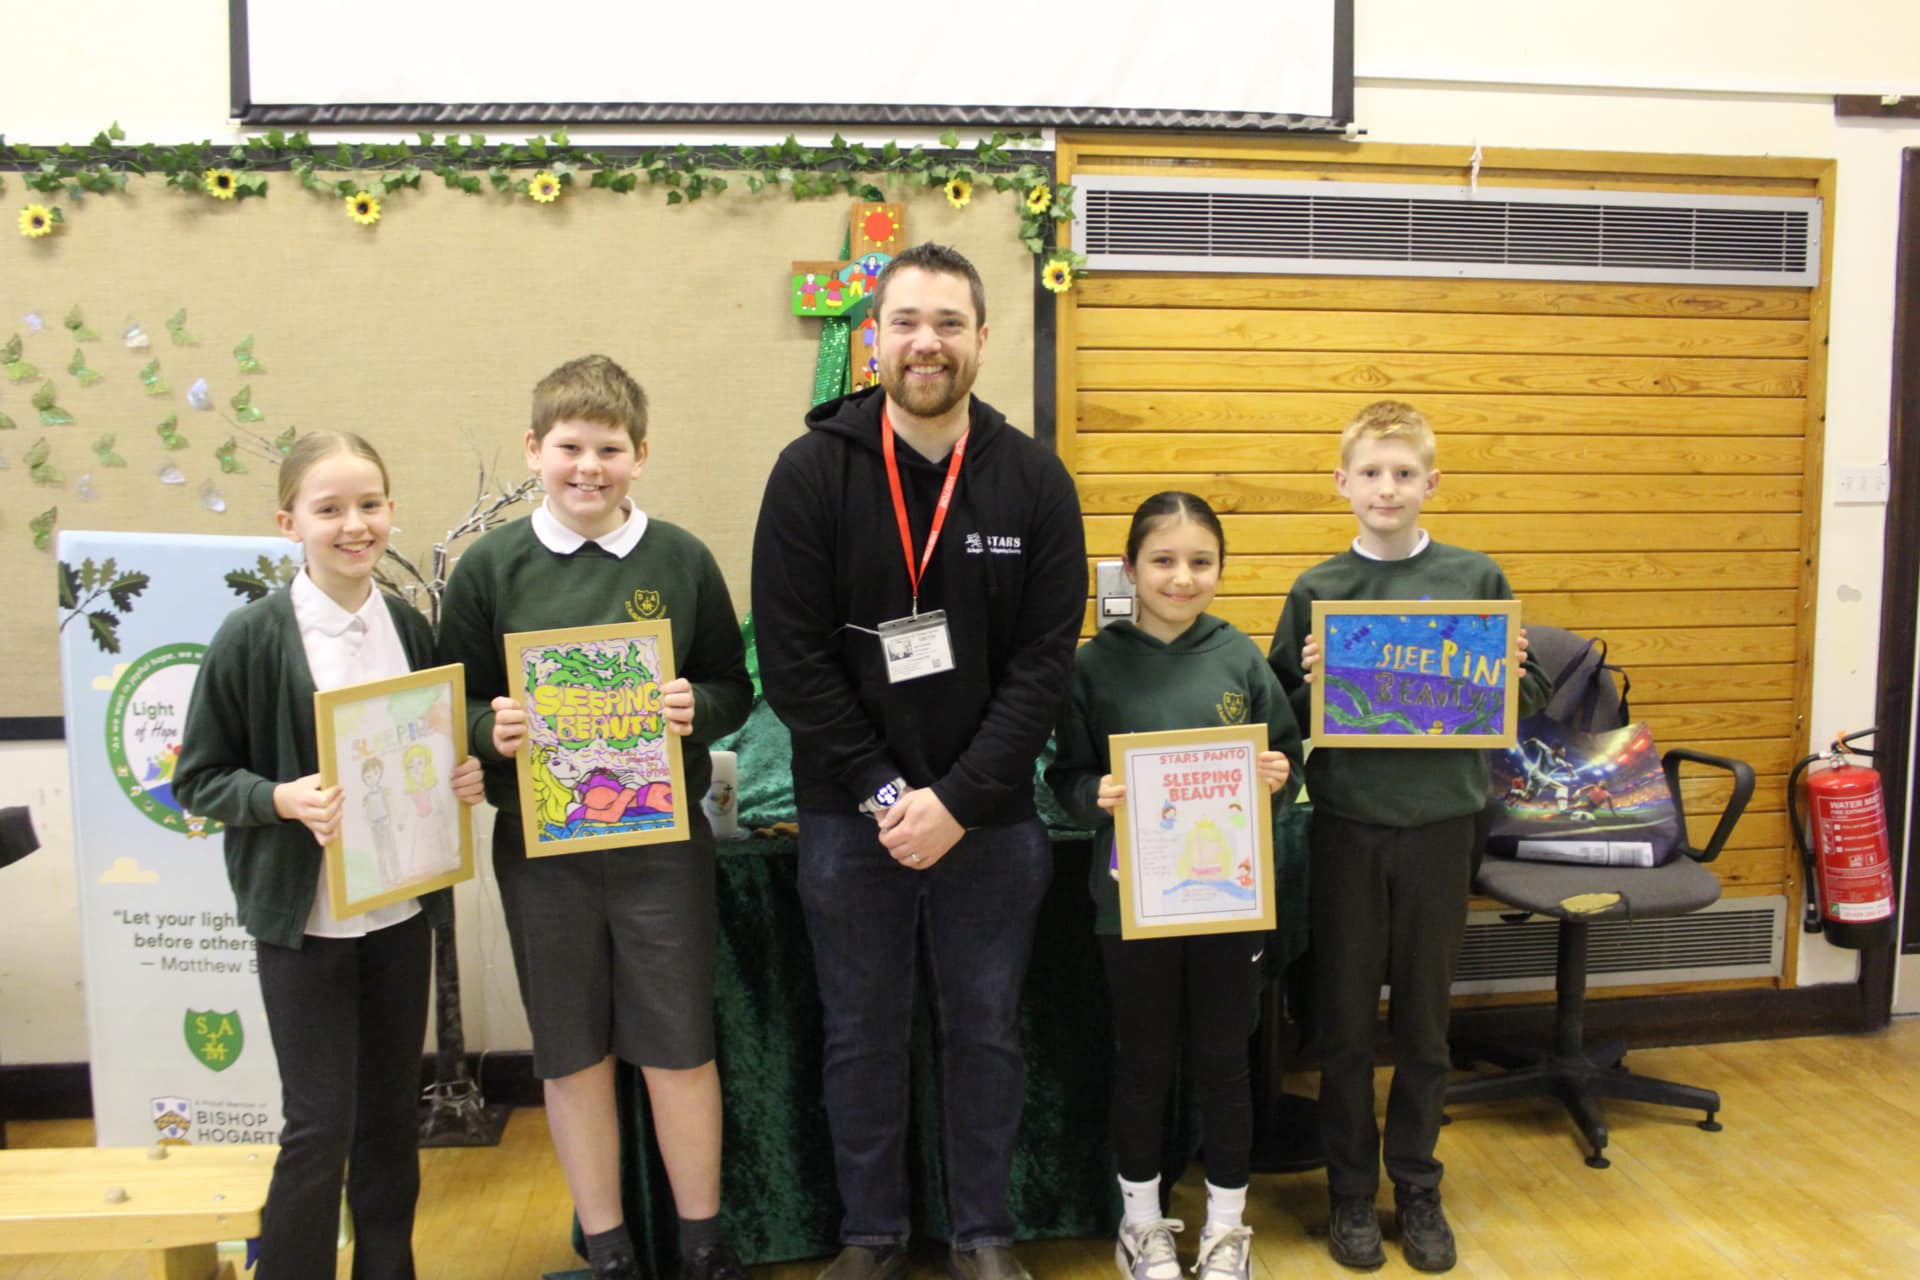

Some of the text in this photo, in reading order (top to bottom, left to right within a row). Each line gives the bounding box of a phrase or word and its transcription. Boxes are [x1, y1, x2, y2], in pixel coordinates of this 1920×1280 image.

[534, 681, 661, 716] SLEEPING
[132, 702, 175, 720] Light
[135, 720, 178, 744] of Hope
[556, 714, 660, 740] BEAUTY
[1160, 748, 1246, 765] STARS PANTO
[1162, 768, 1242, 788] SLEEPING
[1168, 784, 1240, 802] BEAUTY
[1829, 800, 1863, 809] WATER
[156, 914, 195, 930] your
[201, 911, 237, 932] ligh
[134, 932, 193, 949] before
[161, 956, 242, 973] Matthew
[196, 1110, 268, 1127] BISHOP
[198, 1128, 279, 1145] HOGART
